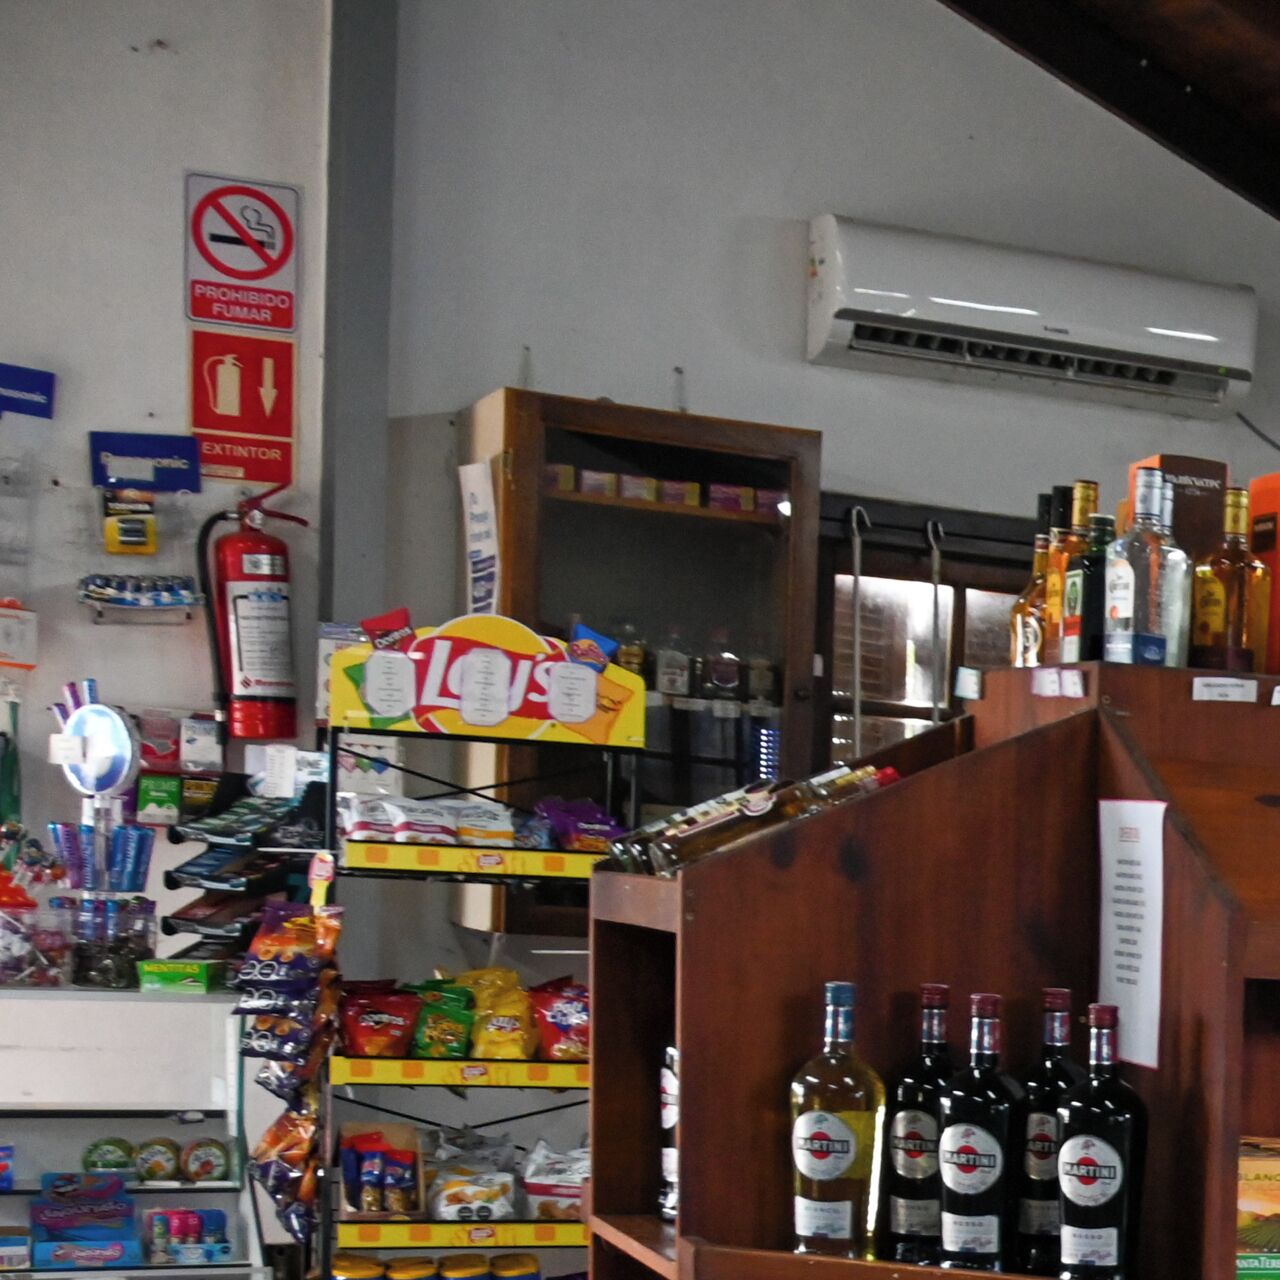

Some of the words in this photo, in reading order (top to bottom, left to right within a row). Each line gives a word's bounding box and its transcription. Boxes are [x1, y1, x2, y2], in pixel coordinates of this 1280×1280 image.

[194, 284, 290, 309] PROHIBIDO
[212, 303, 273, 322] FUMAR
[202, 441, 282, 461] EXTINTOR
[143, 963, 199, 974] MENTITAS
[797, 1137, 849, 1153] MARTINI
[892, 1137, 938, 1152] MARTIN
[944, 1150, 996, 1168] MARTINI
[1063, 1161, 1116, 1179] MARTINI
